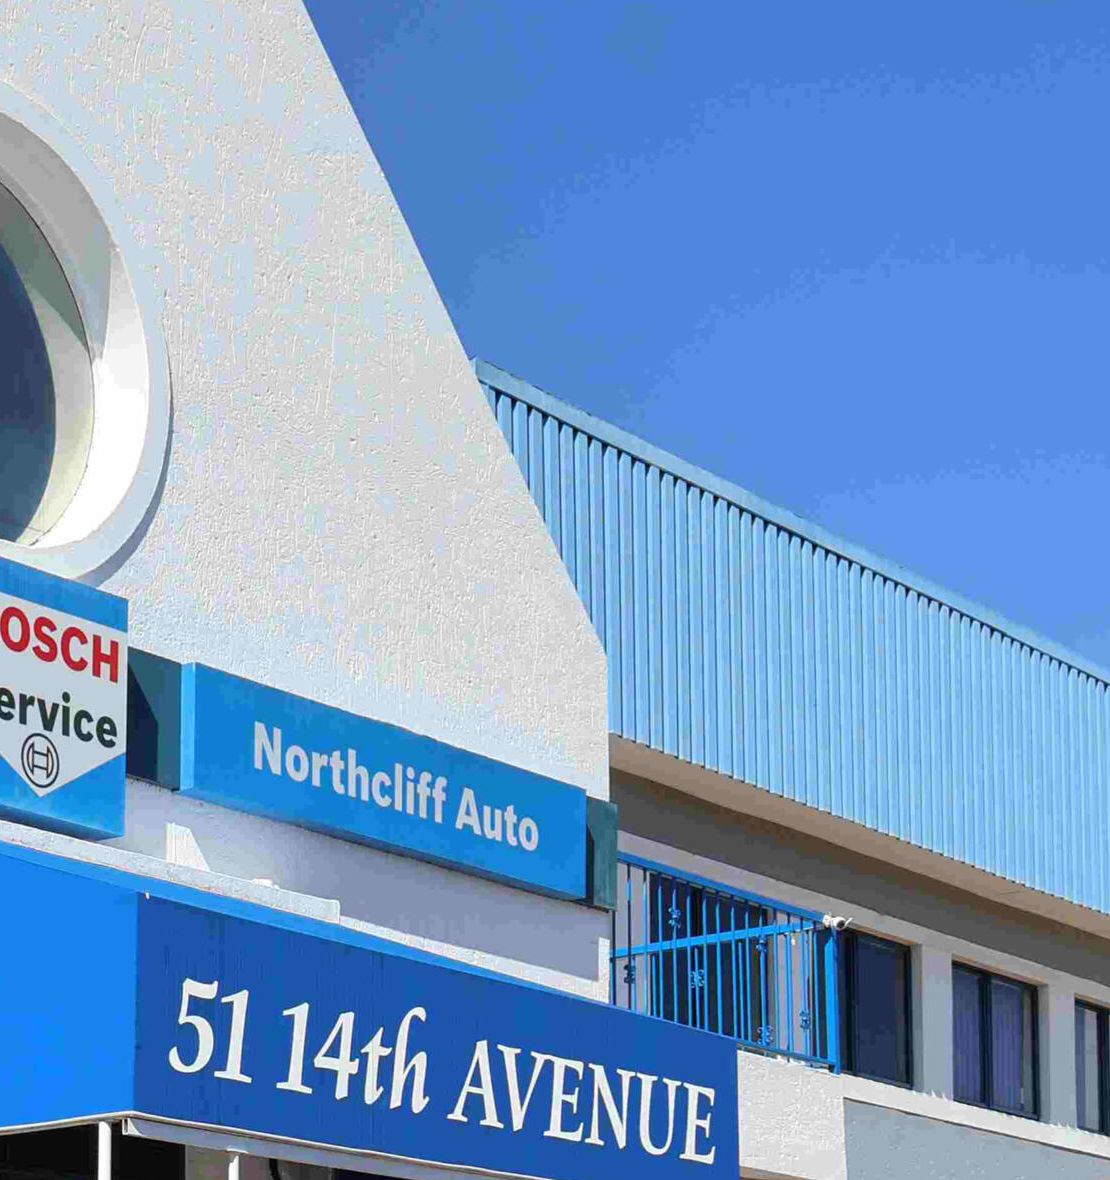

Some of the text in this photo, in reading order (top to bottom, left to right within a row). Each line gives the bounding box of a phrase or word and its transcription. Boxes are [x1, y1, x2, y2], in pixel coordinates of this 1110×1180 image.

[253, 721, 540, 851] Northcliff Auto
[168, 977, 718, 1165] 51 14th AVENUE
